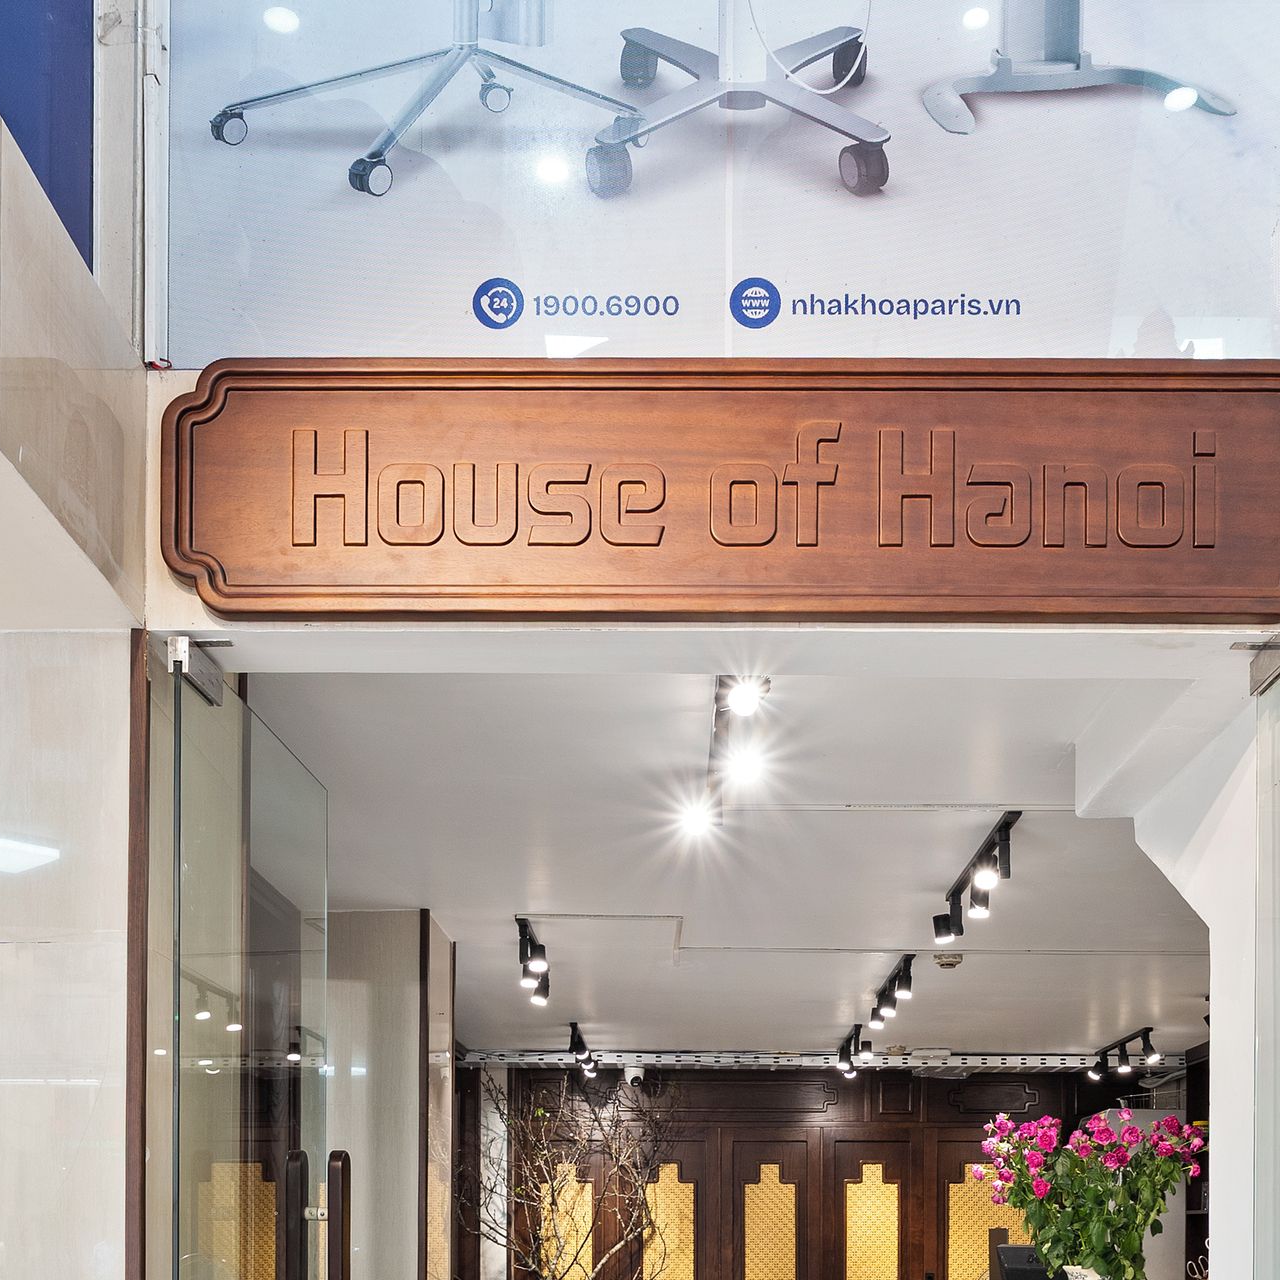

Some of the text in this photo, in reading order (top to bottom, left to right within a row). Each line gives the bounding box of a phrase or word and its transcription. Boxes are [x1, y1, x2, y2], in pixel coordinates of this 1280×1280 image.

[492, 298, 508, 309] 24
[532, 295, 680, 317] 1900.6900
[791, 294, 1021, 319] nhakhoaparis.vn
[291, 421, 1217, 548] House of Hanoi
